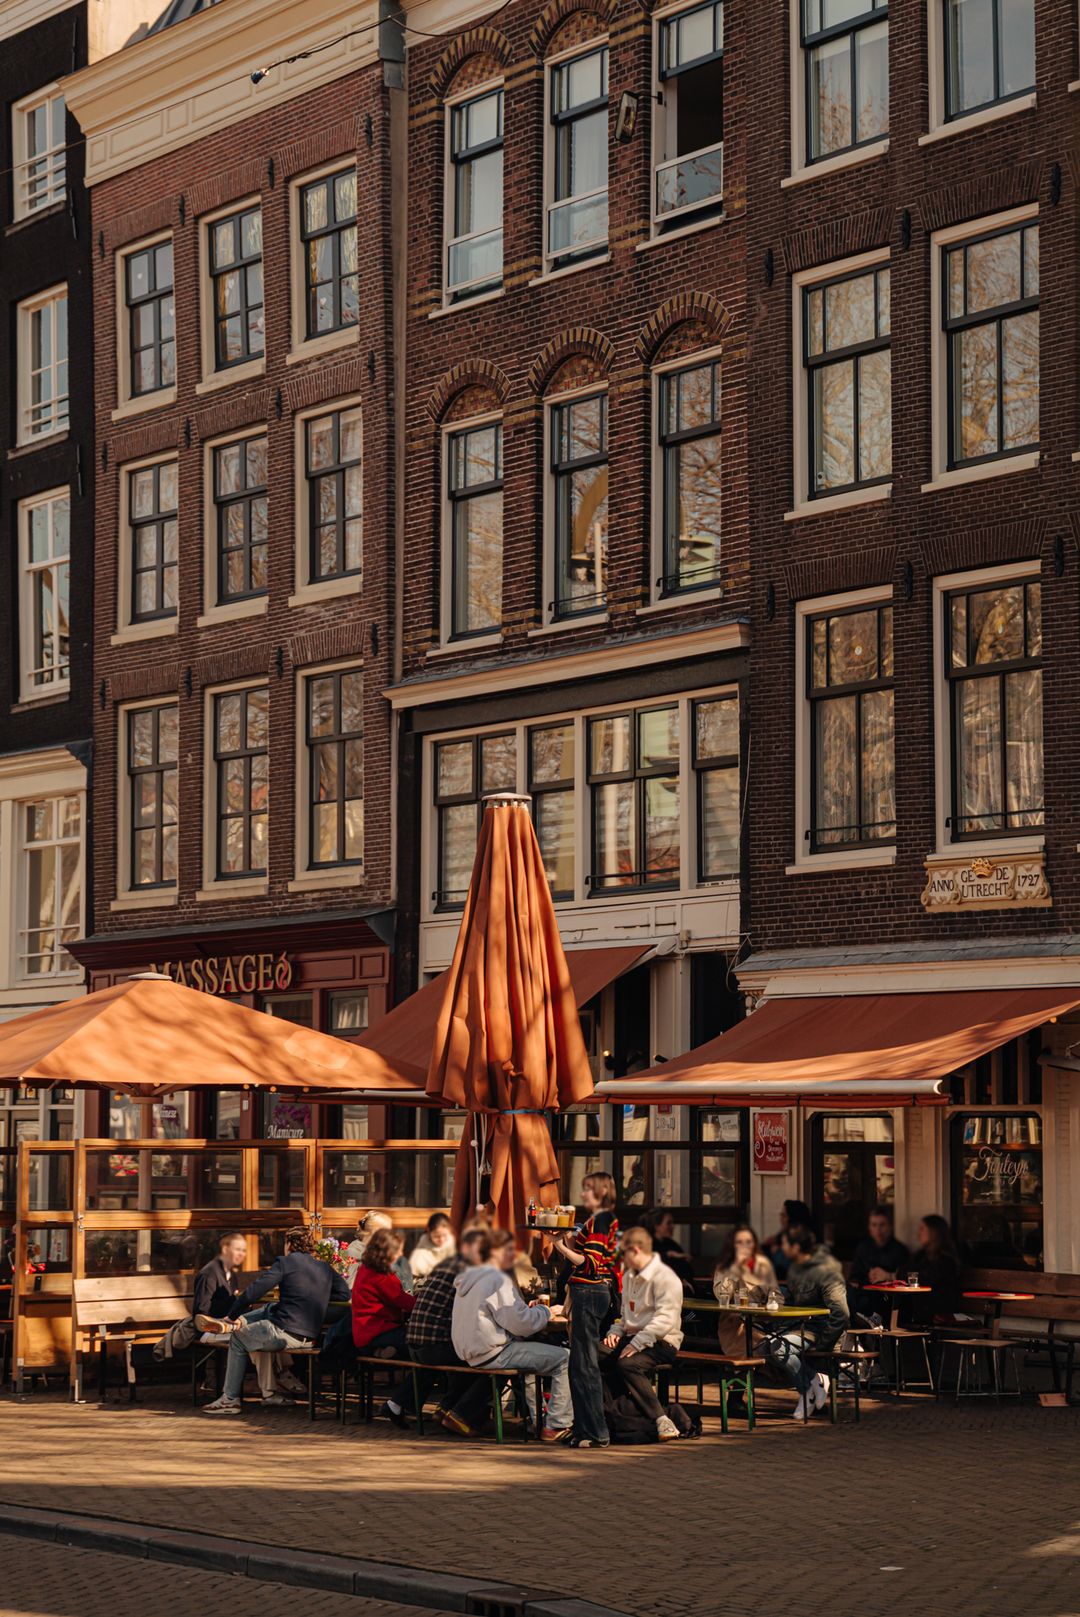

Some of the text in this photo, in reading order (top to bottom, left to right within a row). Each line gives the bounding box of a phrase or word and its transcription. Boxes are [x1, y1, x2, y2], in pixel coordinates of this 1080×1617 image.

[960, 867, 1010, 883] GE DE
[1017, 874, 1040, 888] 1727
[929, 879, 955, 893] ANNO
[961, 882, 1009, 898] UTRECHT
[267, 1124, 304, 1139] Manicure
